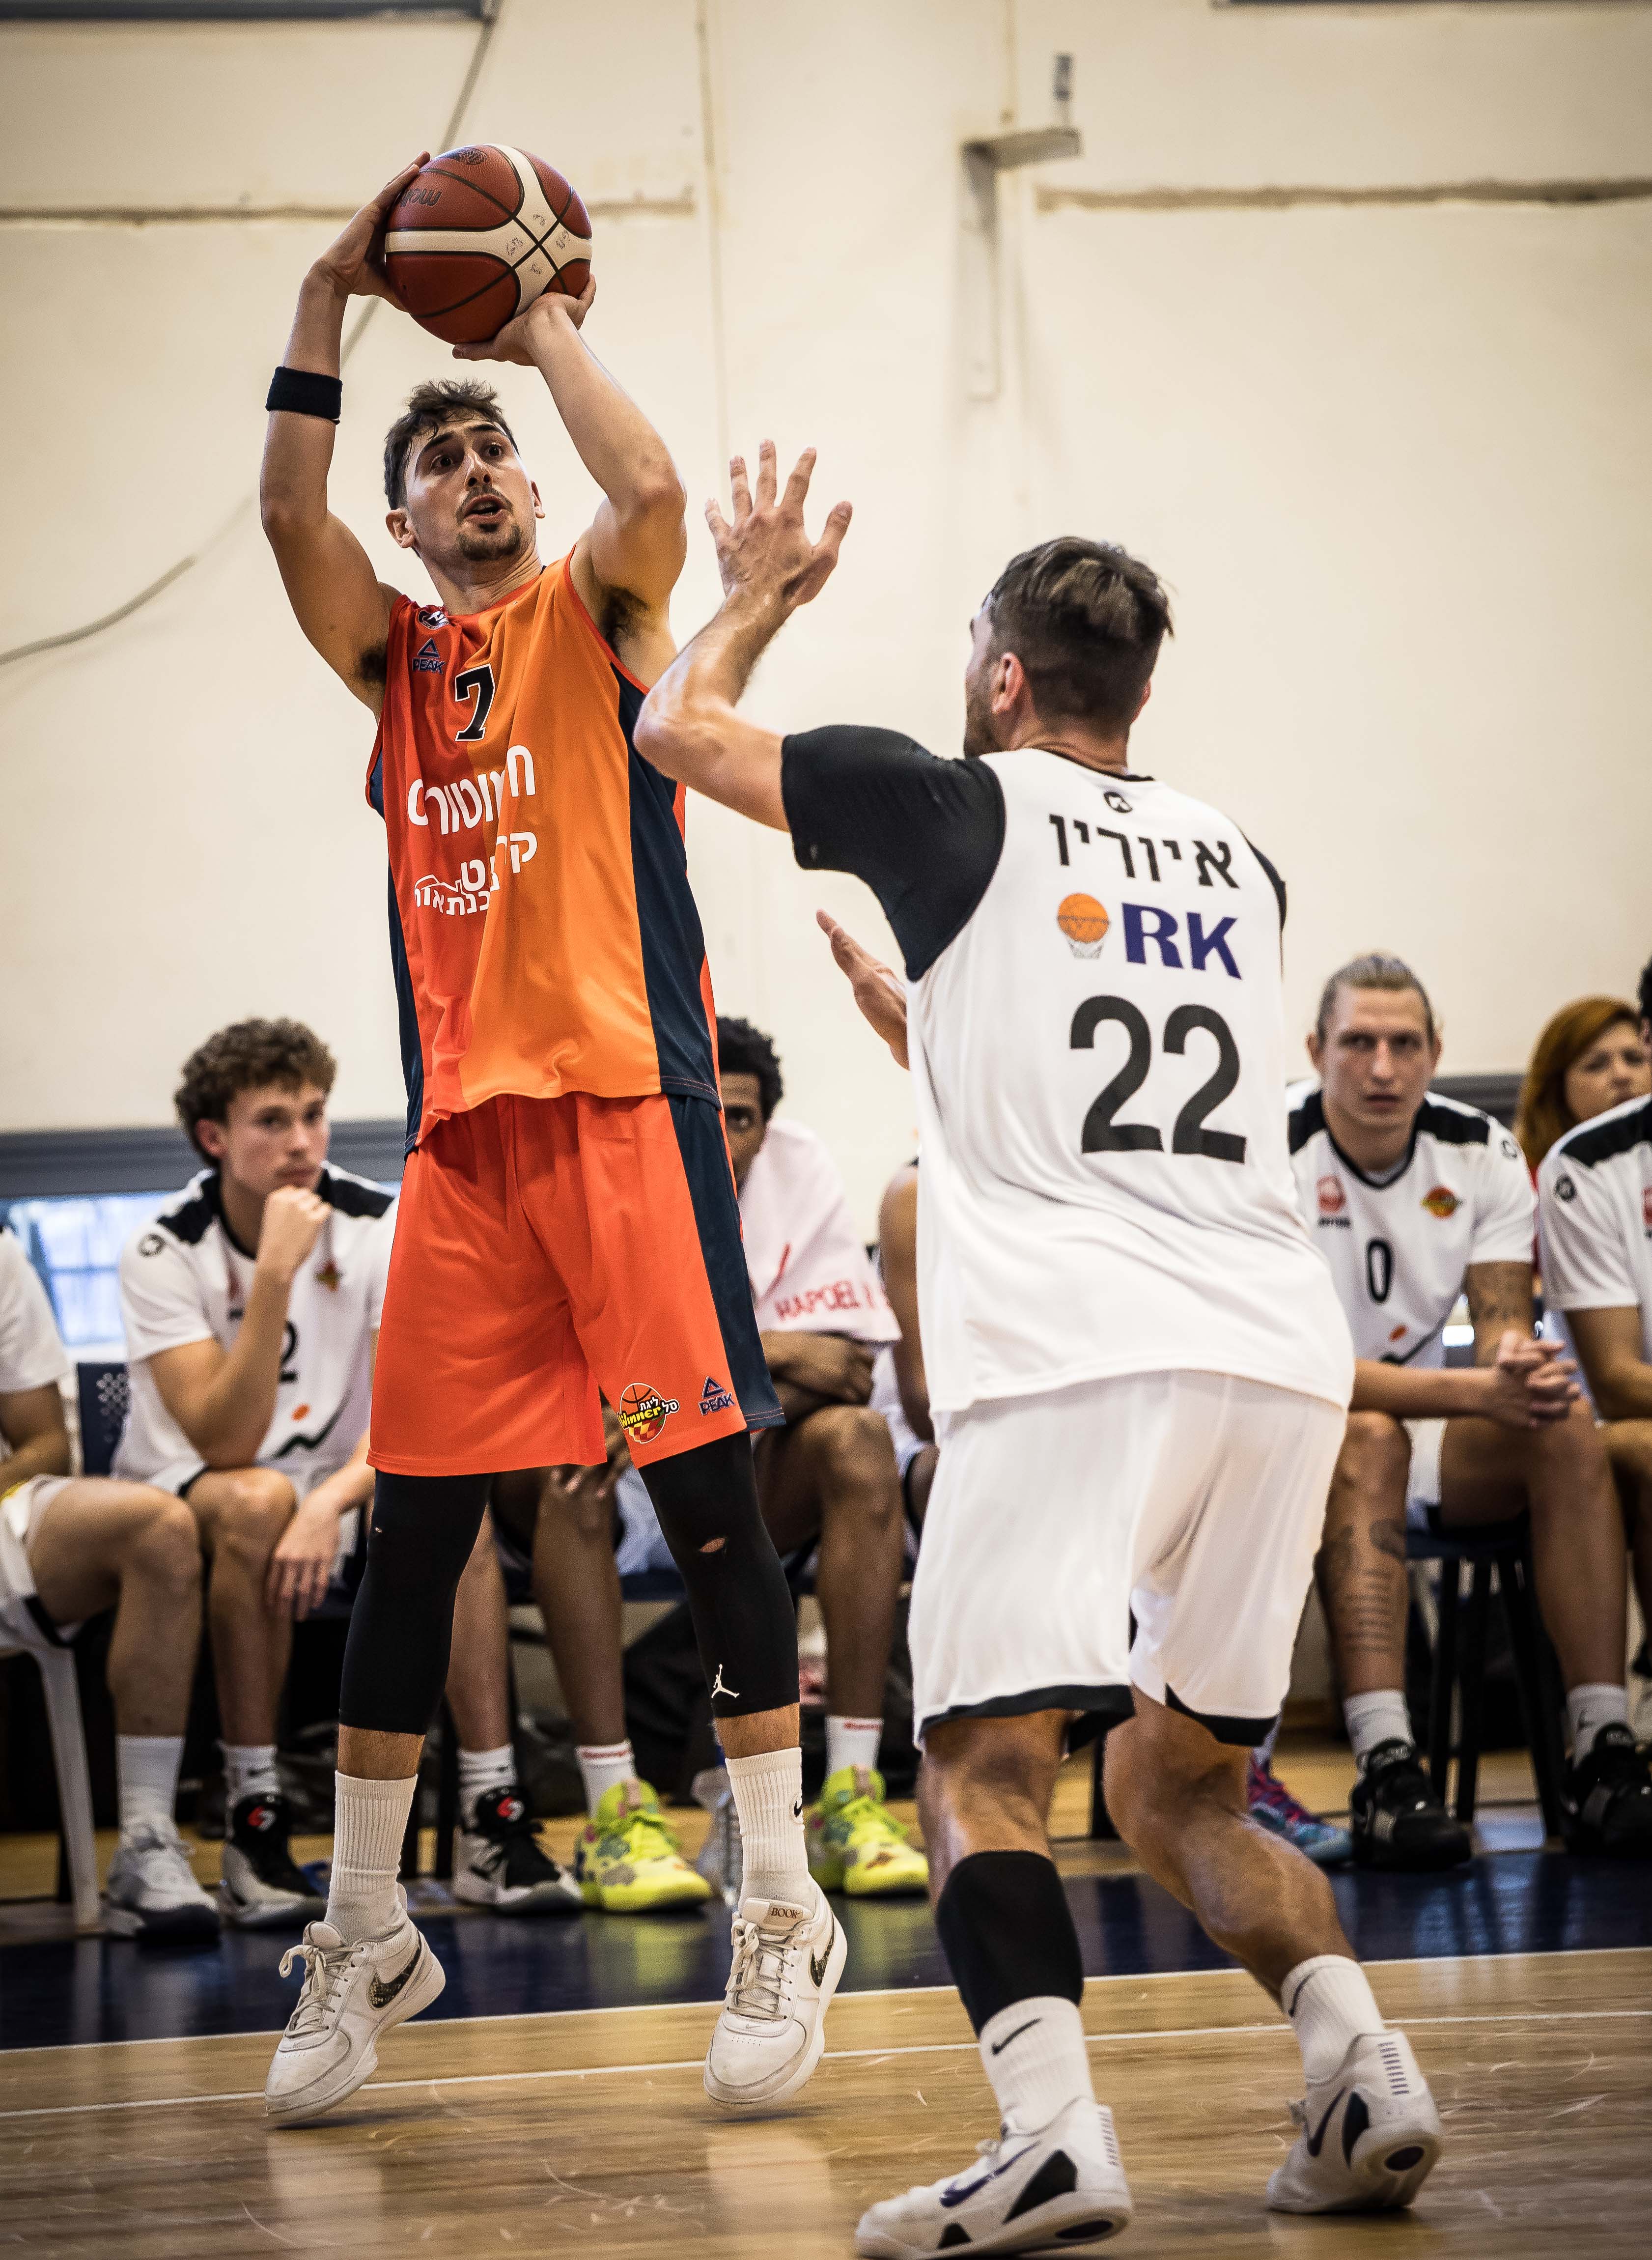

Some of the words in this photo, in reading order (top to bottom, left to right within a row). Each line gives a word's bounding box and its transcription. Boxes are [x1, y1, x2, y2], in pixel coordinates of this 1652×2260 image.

[412, 657, 446, 675] PEAK
[454, 663, 496, 742] 7
[1049, 813, 1240, 889] איורין
[1121, 902, 1242, 980] RK
[1069, 994, 1248, 1164] 22
[1366, 1239, 1393, 1303] 0
[618, 1406, 661, 1427] Winner
[662, 1401, 678, 1413] סל
[640, 1396, 659, 1411] ליגת
[698, 1392, 736, 1416] PEAK
[771, 1907, 798, 1919] BOOK
